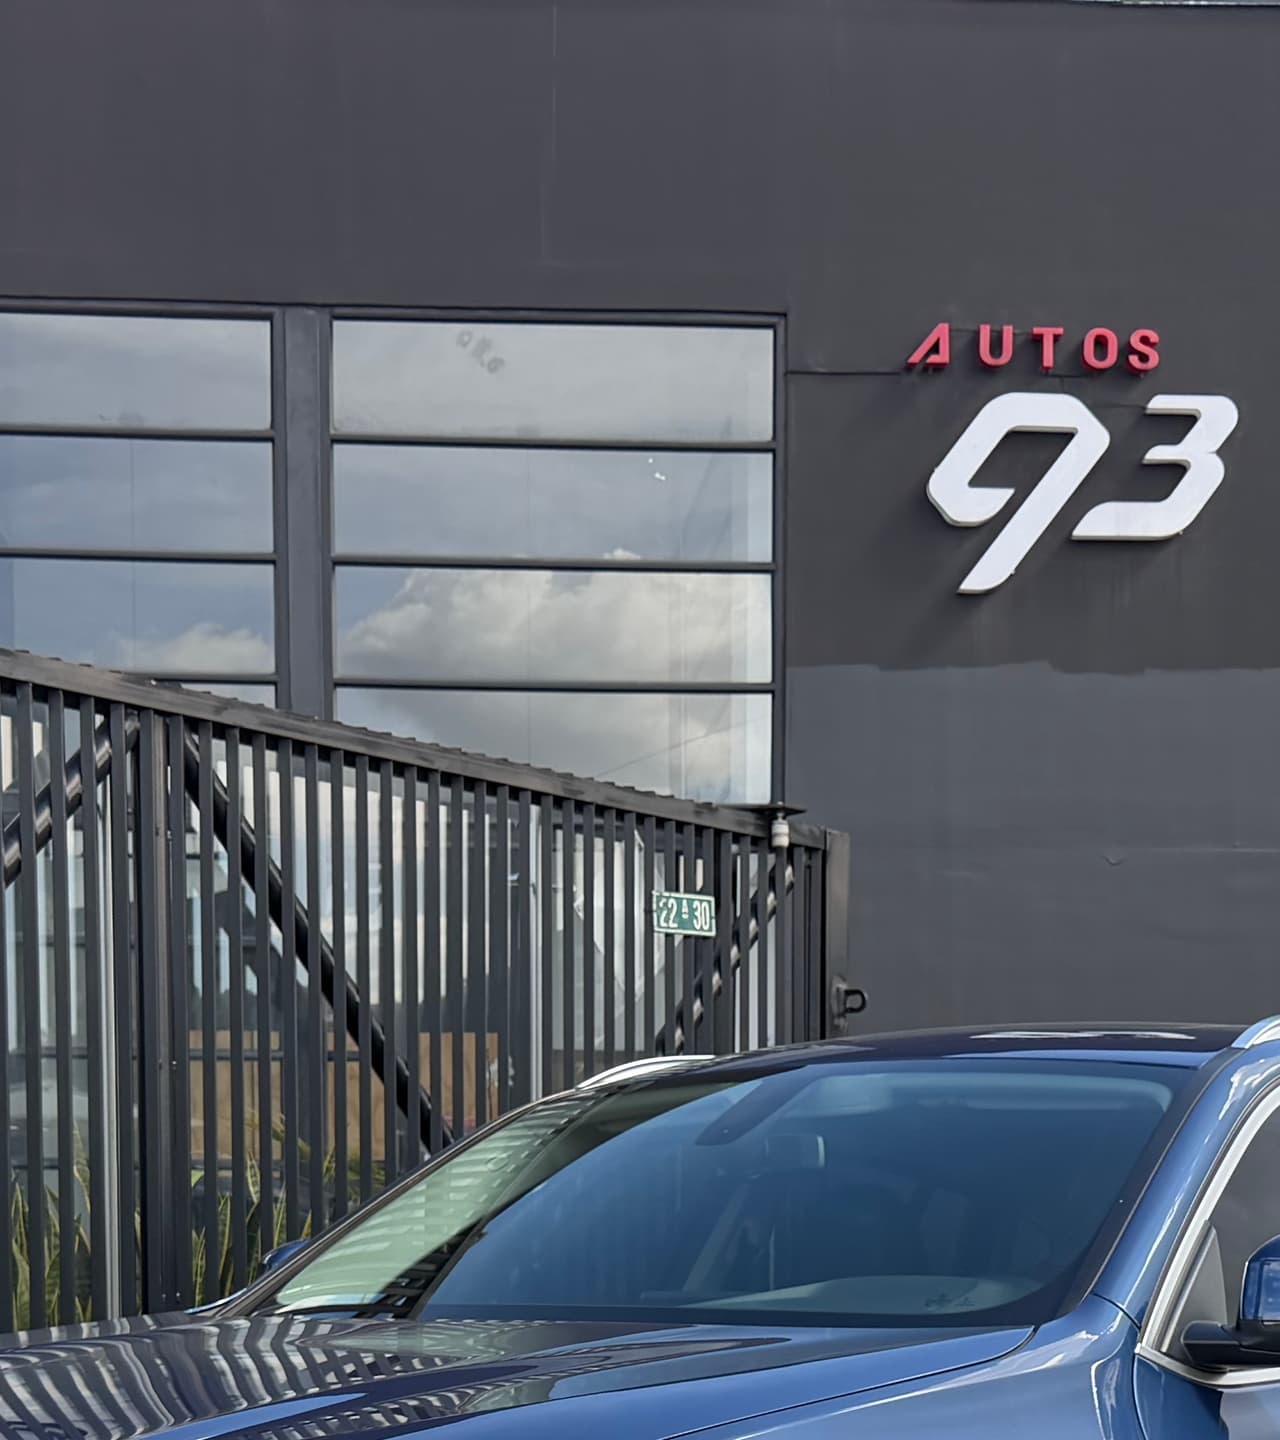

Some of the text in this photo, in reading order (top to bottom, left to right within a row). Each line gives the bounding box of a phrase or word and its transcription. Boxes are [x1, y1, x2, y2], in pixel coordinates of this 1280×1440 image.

[905, 322, 1161, 373] AUTOS
[926, 391, 1240, 595] 93
[693, 900, 710, 930] 30
